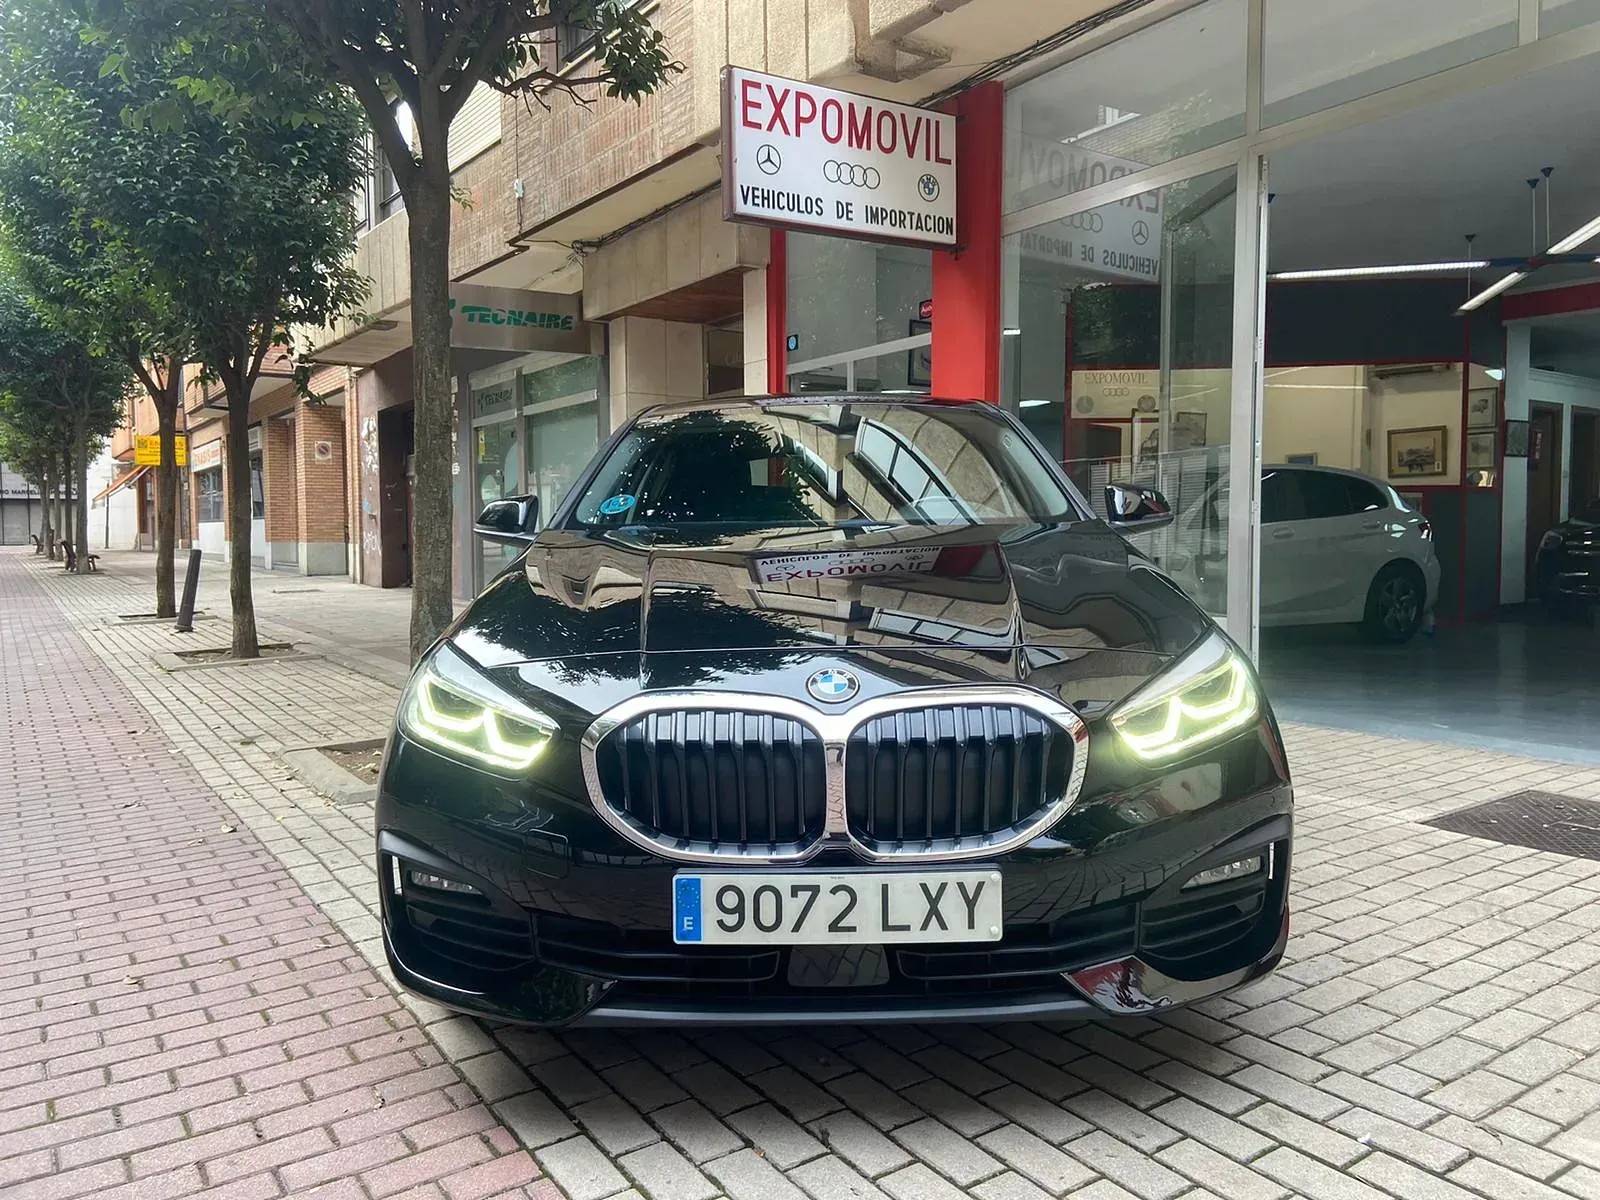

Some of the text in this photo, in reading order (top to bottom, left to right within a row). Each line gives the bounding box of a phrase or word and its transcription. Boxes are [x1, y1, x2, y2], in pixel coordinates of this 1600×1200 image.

[741, 79, 952, 166] EXPOMOVIL
[740, 184, 954, 236] VEHICULOS DE IMPORTACION
[461, 305, 573, 331] TECNAIRE
[1083, 372, 1148, 385] EXPOMOVIL
[683, 917, 694, 931] E
[715, 880, 986, 934] 9072 LXY
